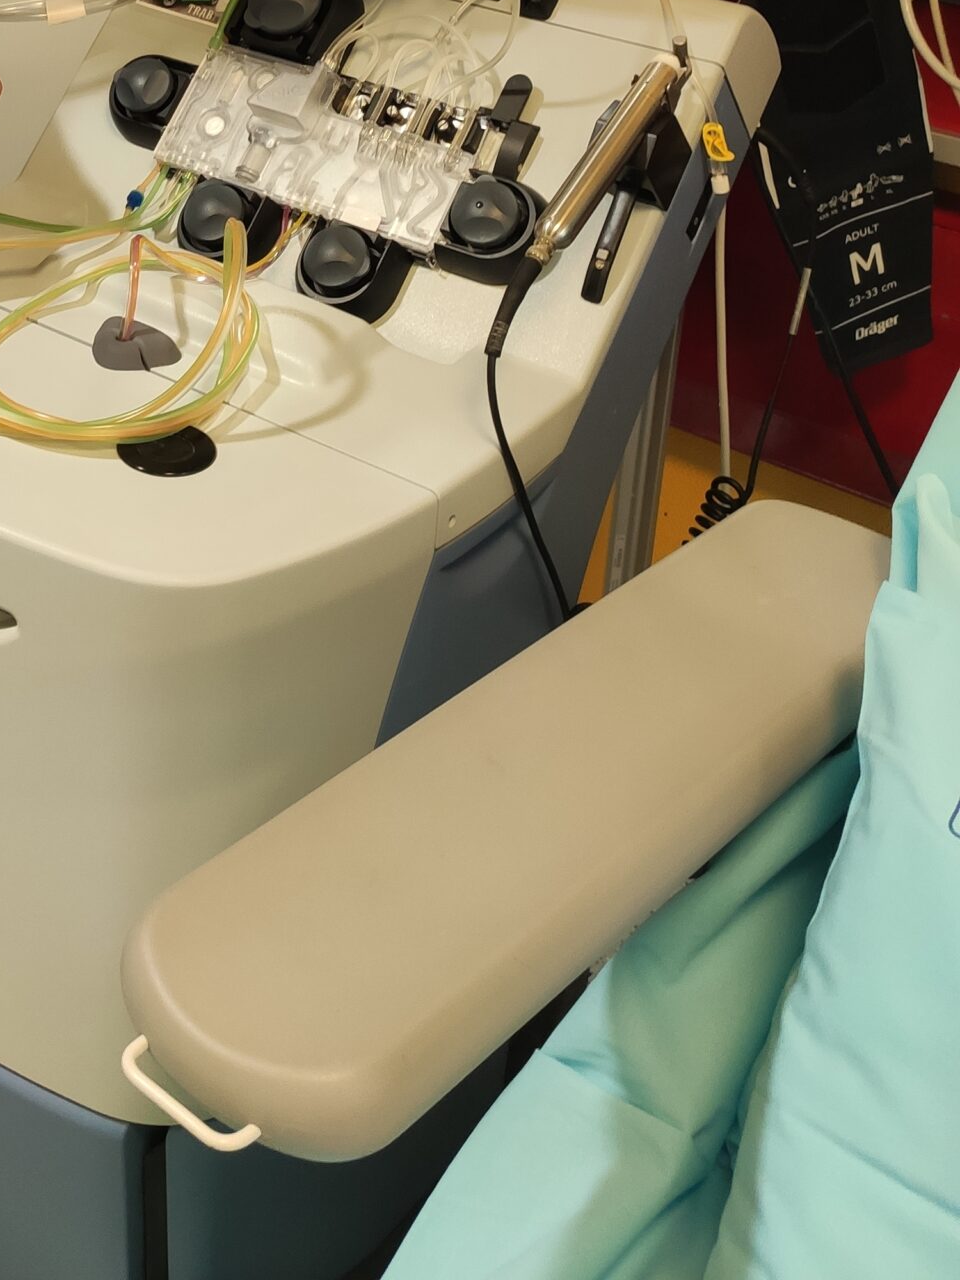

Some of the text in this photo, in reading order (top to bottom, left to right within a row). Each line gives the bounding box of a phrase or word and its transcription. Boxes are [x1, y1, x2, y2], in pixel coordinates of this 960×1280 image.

[844, 223, 880, 245] ADULT
[849, 242, 885, 286] M
[849, 280, 898, 308] 23-33 cm
[855, 314, 900, 341] Dräger
